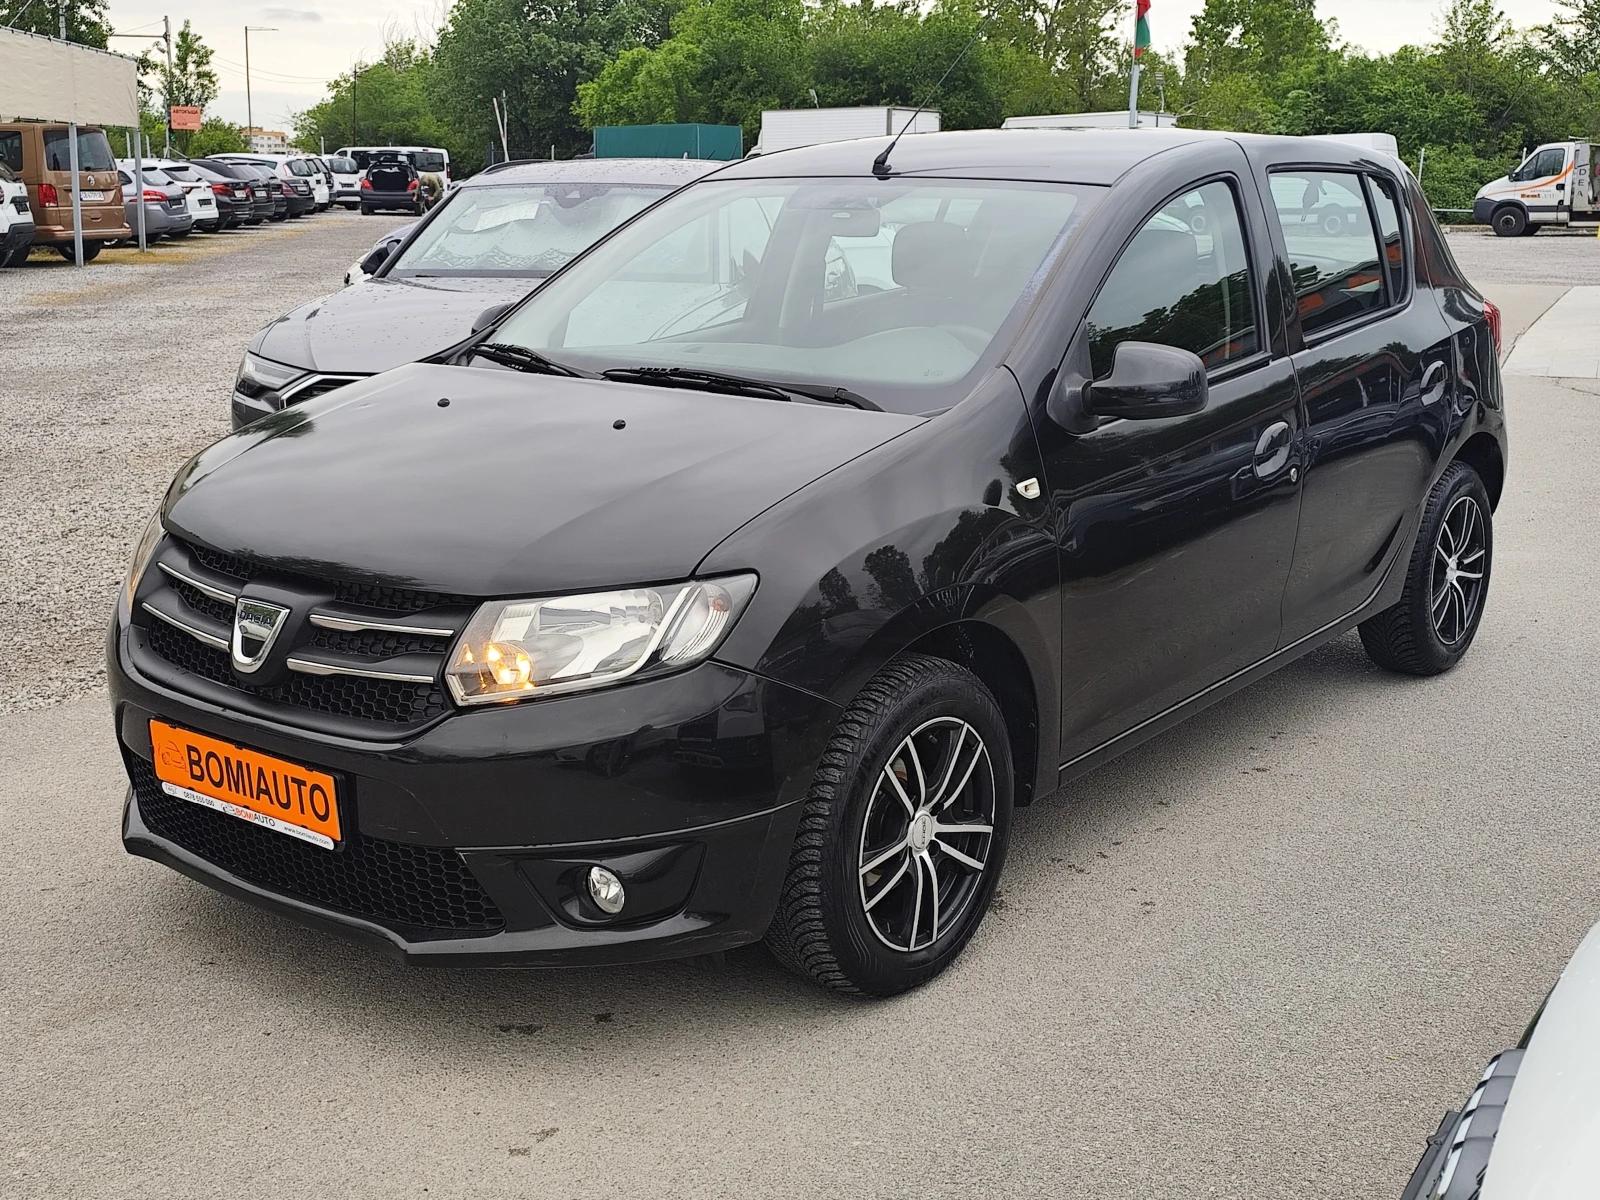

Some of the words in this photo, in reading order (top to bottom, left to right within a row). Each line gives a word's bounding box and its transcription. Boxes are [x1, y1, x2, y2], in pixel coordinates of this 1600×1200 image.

[240, 611, 273, 627] DACIA
[187, 744, 330, 822] BOMIAUTO
[235, 807, 275, 827] BOMIAUTO
